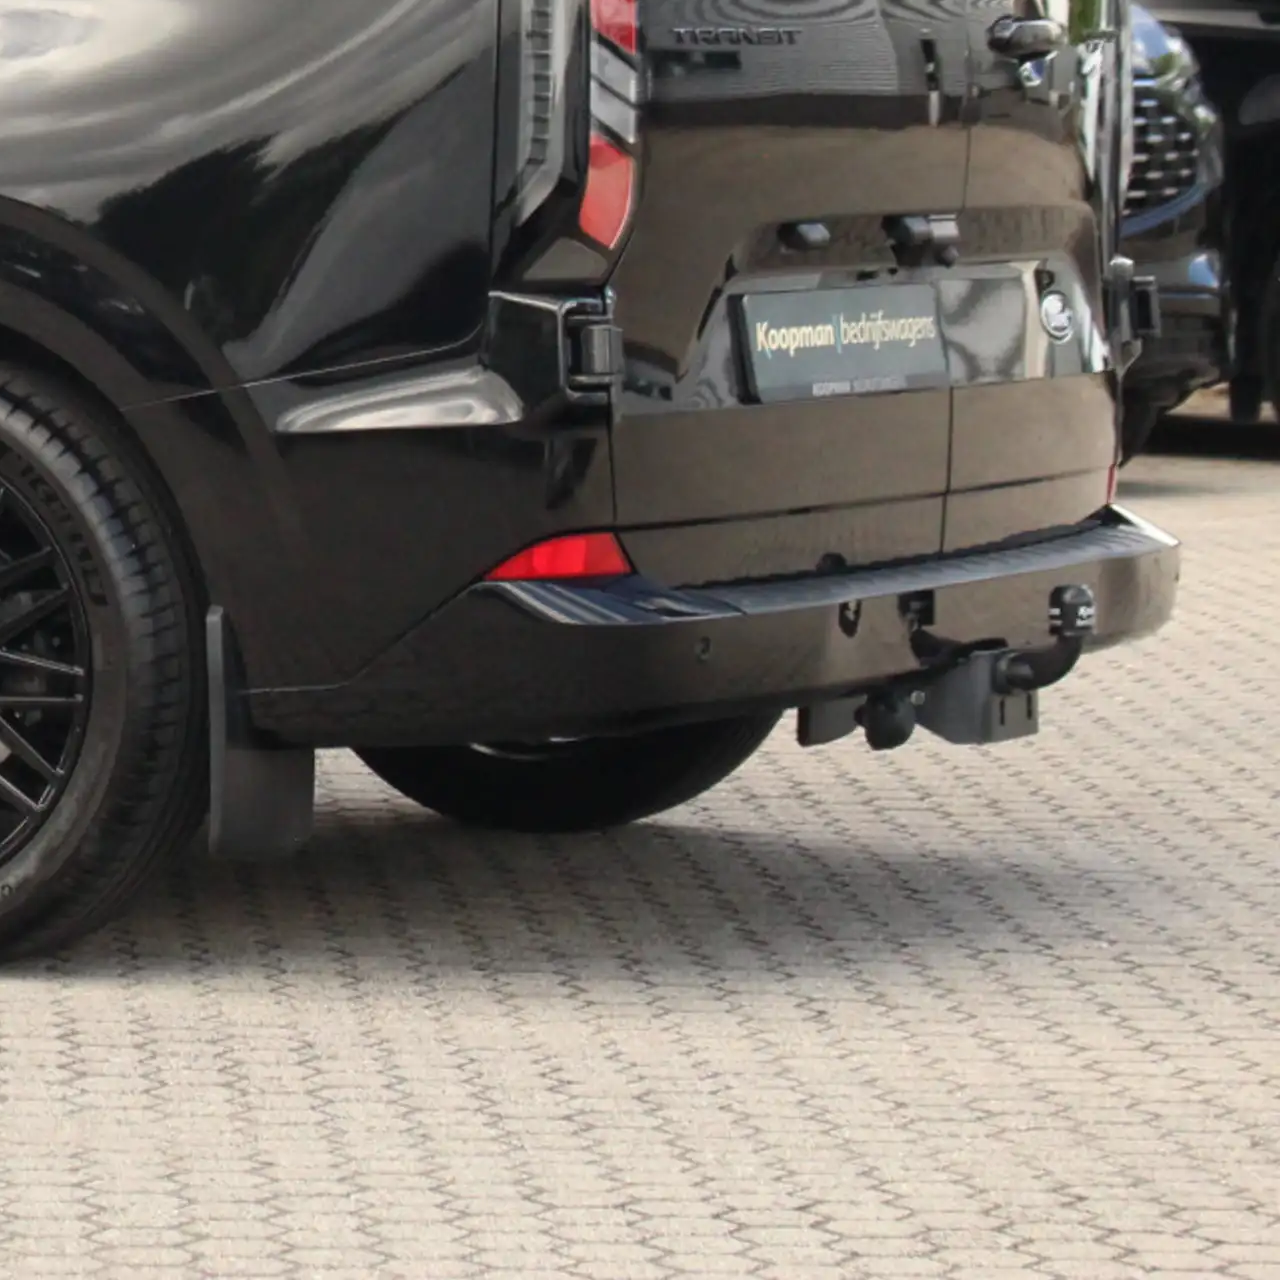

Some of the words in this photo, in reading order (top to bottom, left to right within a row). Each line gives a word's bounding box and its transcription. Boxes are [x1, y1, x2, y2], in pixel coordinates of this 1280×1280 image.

[672, 26, 803, 45] TRANSIT
[755, 320, 835, 357] Koopman
[840, 309, 936, 351] bedrijfswagens
